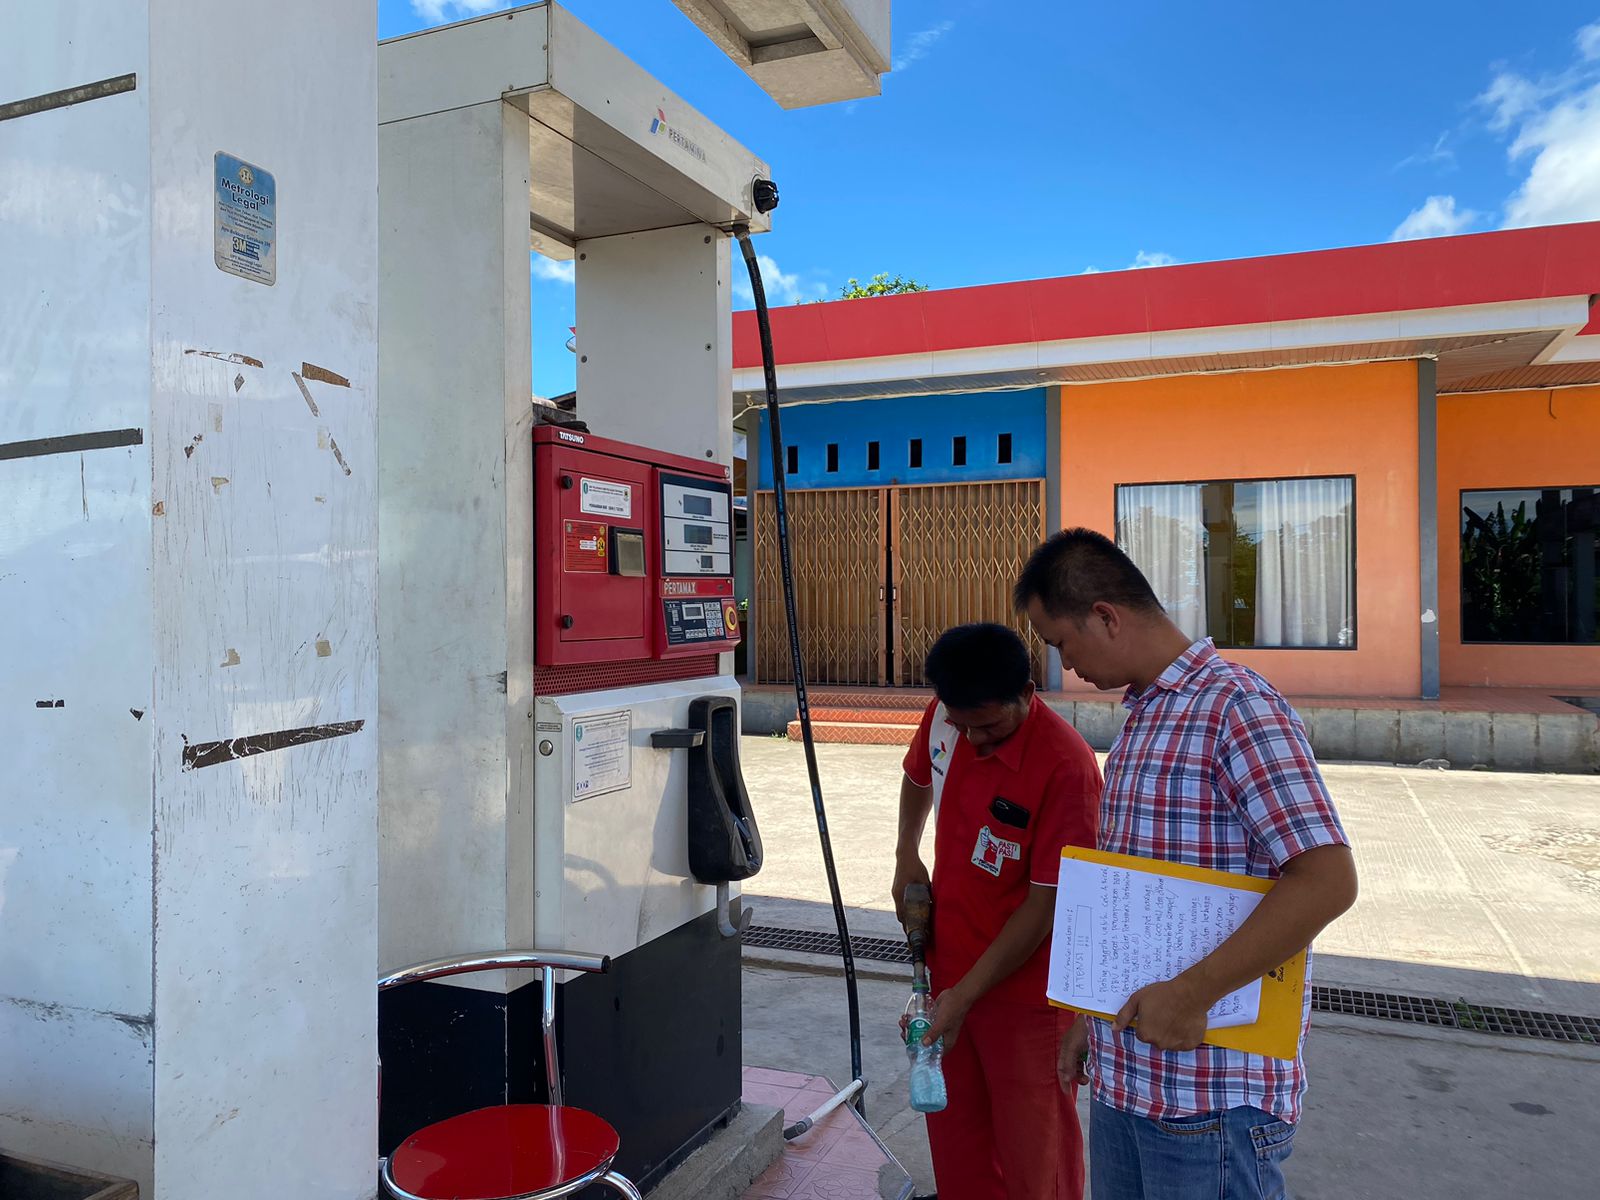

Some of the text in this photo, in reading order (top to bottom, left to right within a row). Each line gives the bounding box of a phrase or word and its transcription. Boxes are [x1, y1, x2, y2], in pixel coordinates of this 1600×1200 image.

[668, 128, 706, 162] PERTAMINA
[221, 177, 269, 206] Metrologi
[232, 192, 259, 211] Legal
[232, 237, 247, 253] 3M
[559, 431, 584, 444] TATSUNO
[664, 581, 697, 596] PERTAMAX
[998, 840, 1018, 852] PASTI
[1075, 952, 1085, 989] ATENSI
